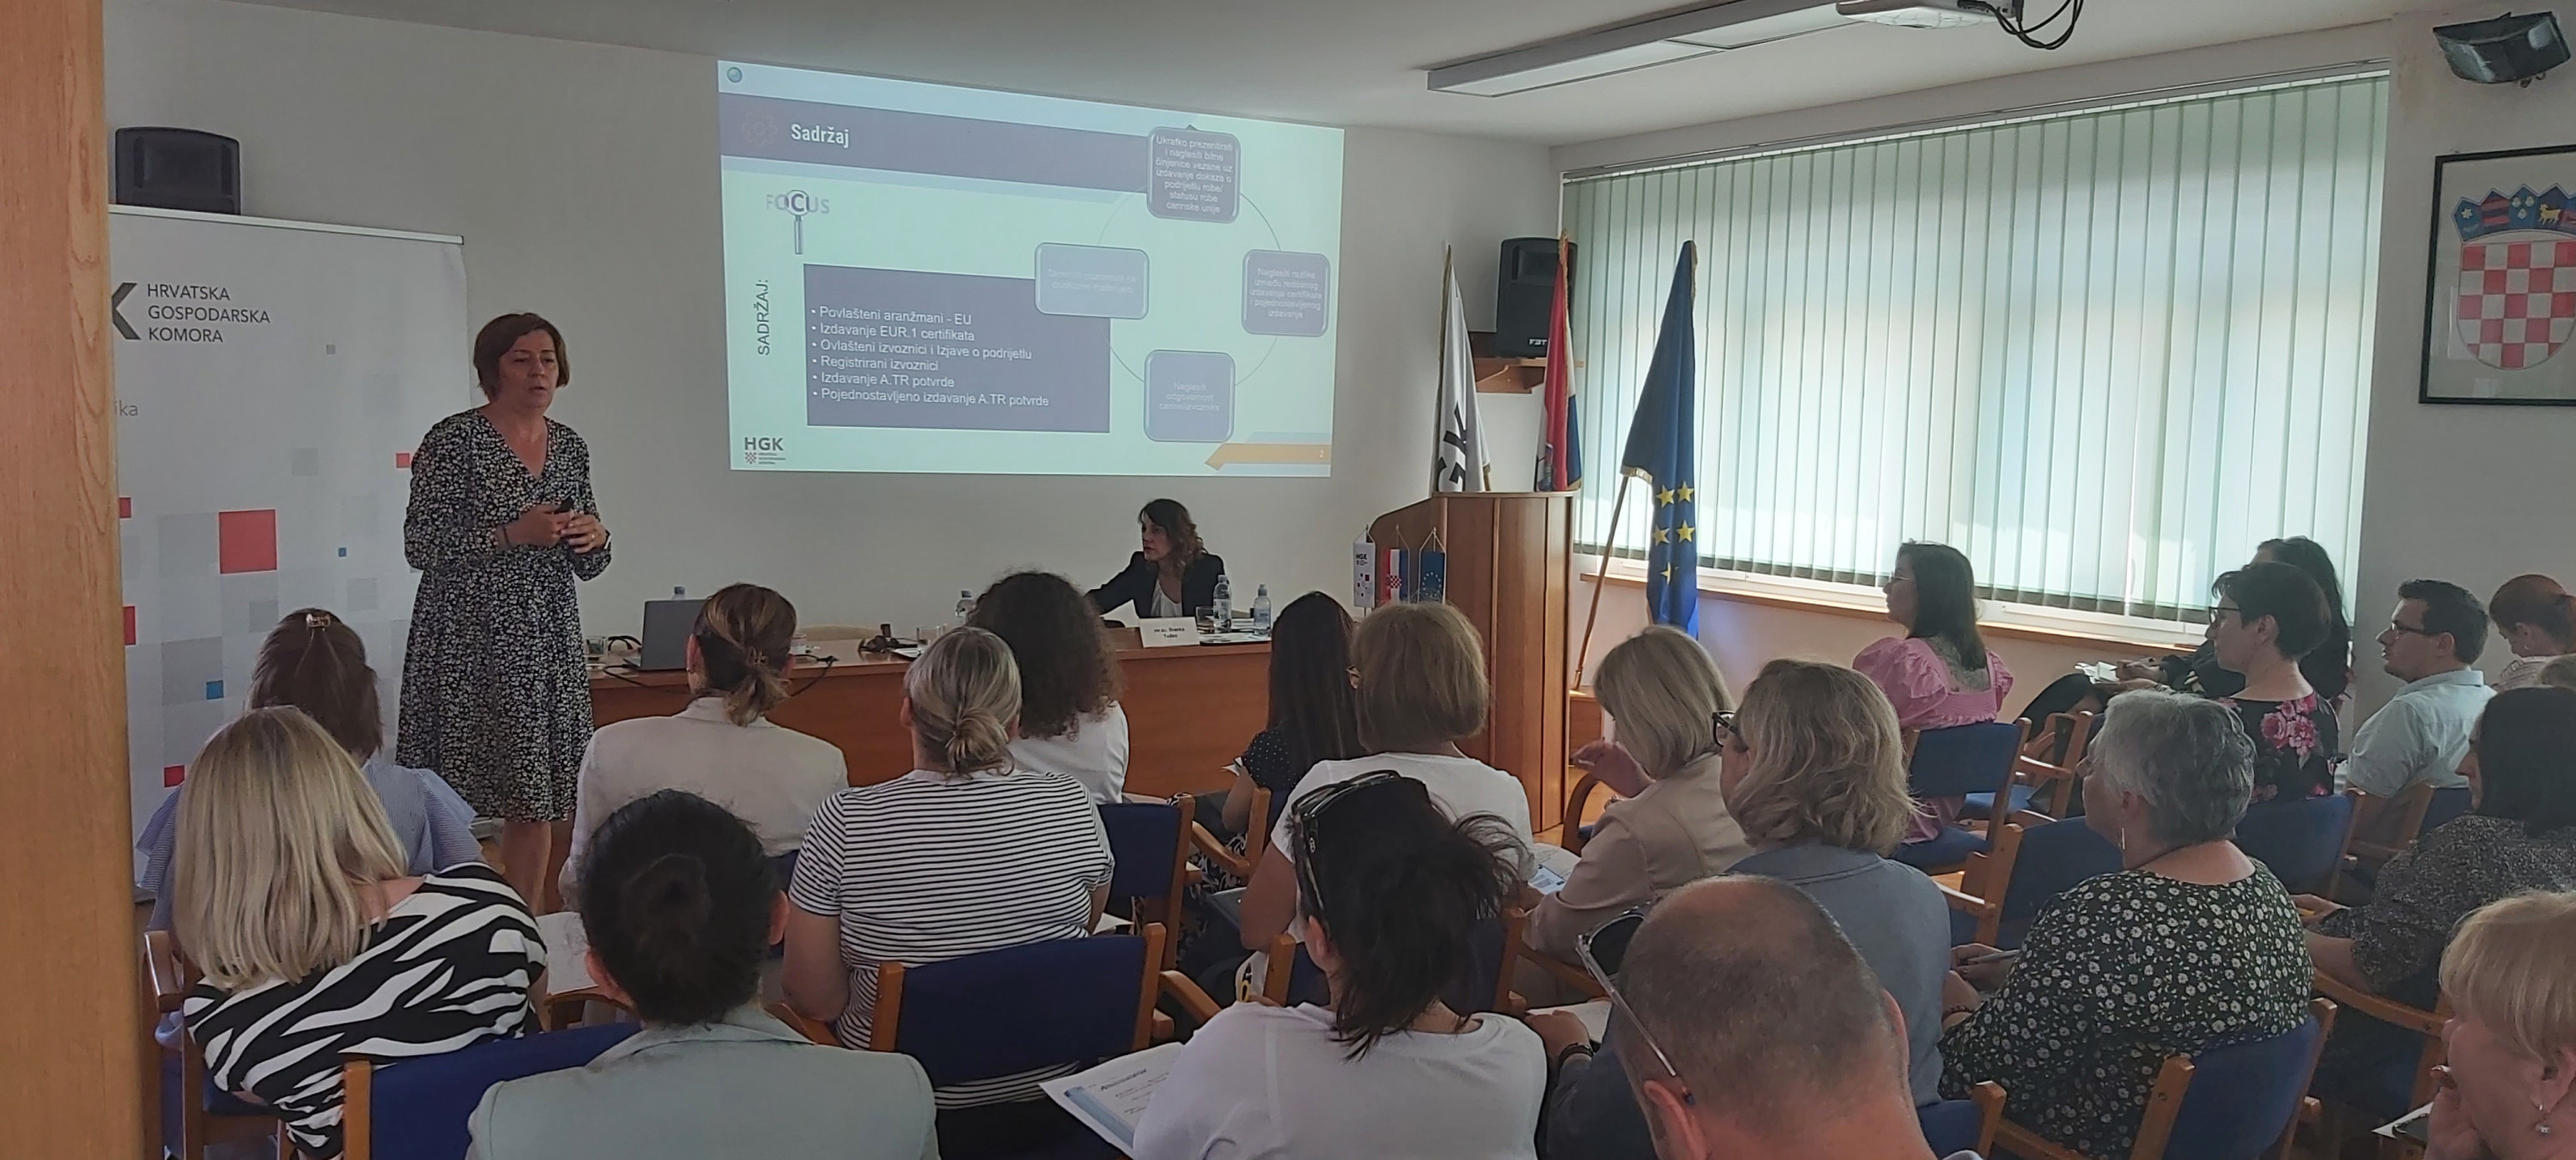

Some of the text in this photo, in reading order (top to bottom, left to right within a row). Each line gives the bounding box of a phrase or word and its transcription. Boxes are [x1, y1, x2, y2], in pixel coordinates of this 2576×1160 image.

[791, 124, 850, 149] Sadržaj
[766, 193, 829, 214] FOCUS
[147, 283, 230, 301] HRVATSKA
[148, 305, 270, 324] GOSPODARSKA
[753, 279, 770, 356] SADRŽAJ:
[820, 306, 881, 319] Povlašteni
[884, 312, 944, 324] aranžmani
[954, 313, 972, 325] EU
[149, 327, 223, 343] KOMORA
[820, 323, 975, 341] Izdavanje EUR.1 certifikata
[820, 339, 876, 353] Ovlašteni
[878, 342, 927, 355] izvoznici
[937, 344, 969, 358] Izjave
[972, 348, 980, 357] o
[982, 347, 1032, 361] podrijetlu
[821, 355, 939, 371] Registrirani izvoznici
[822, 372, 955, 388] Izdavanje A.TR potvrde
[822, 388, 1049, 407] Pojednostavljeno izdavanje A.TR potvrde
[744, 437, 784, 451] HGK
